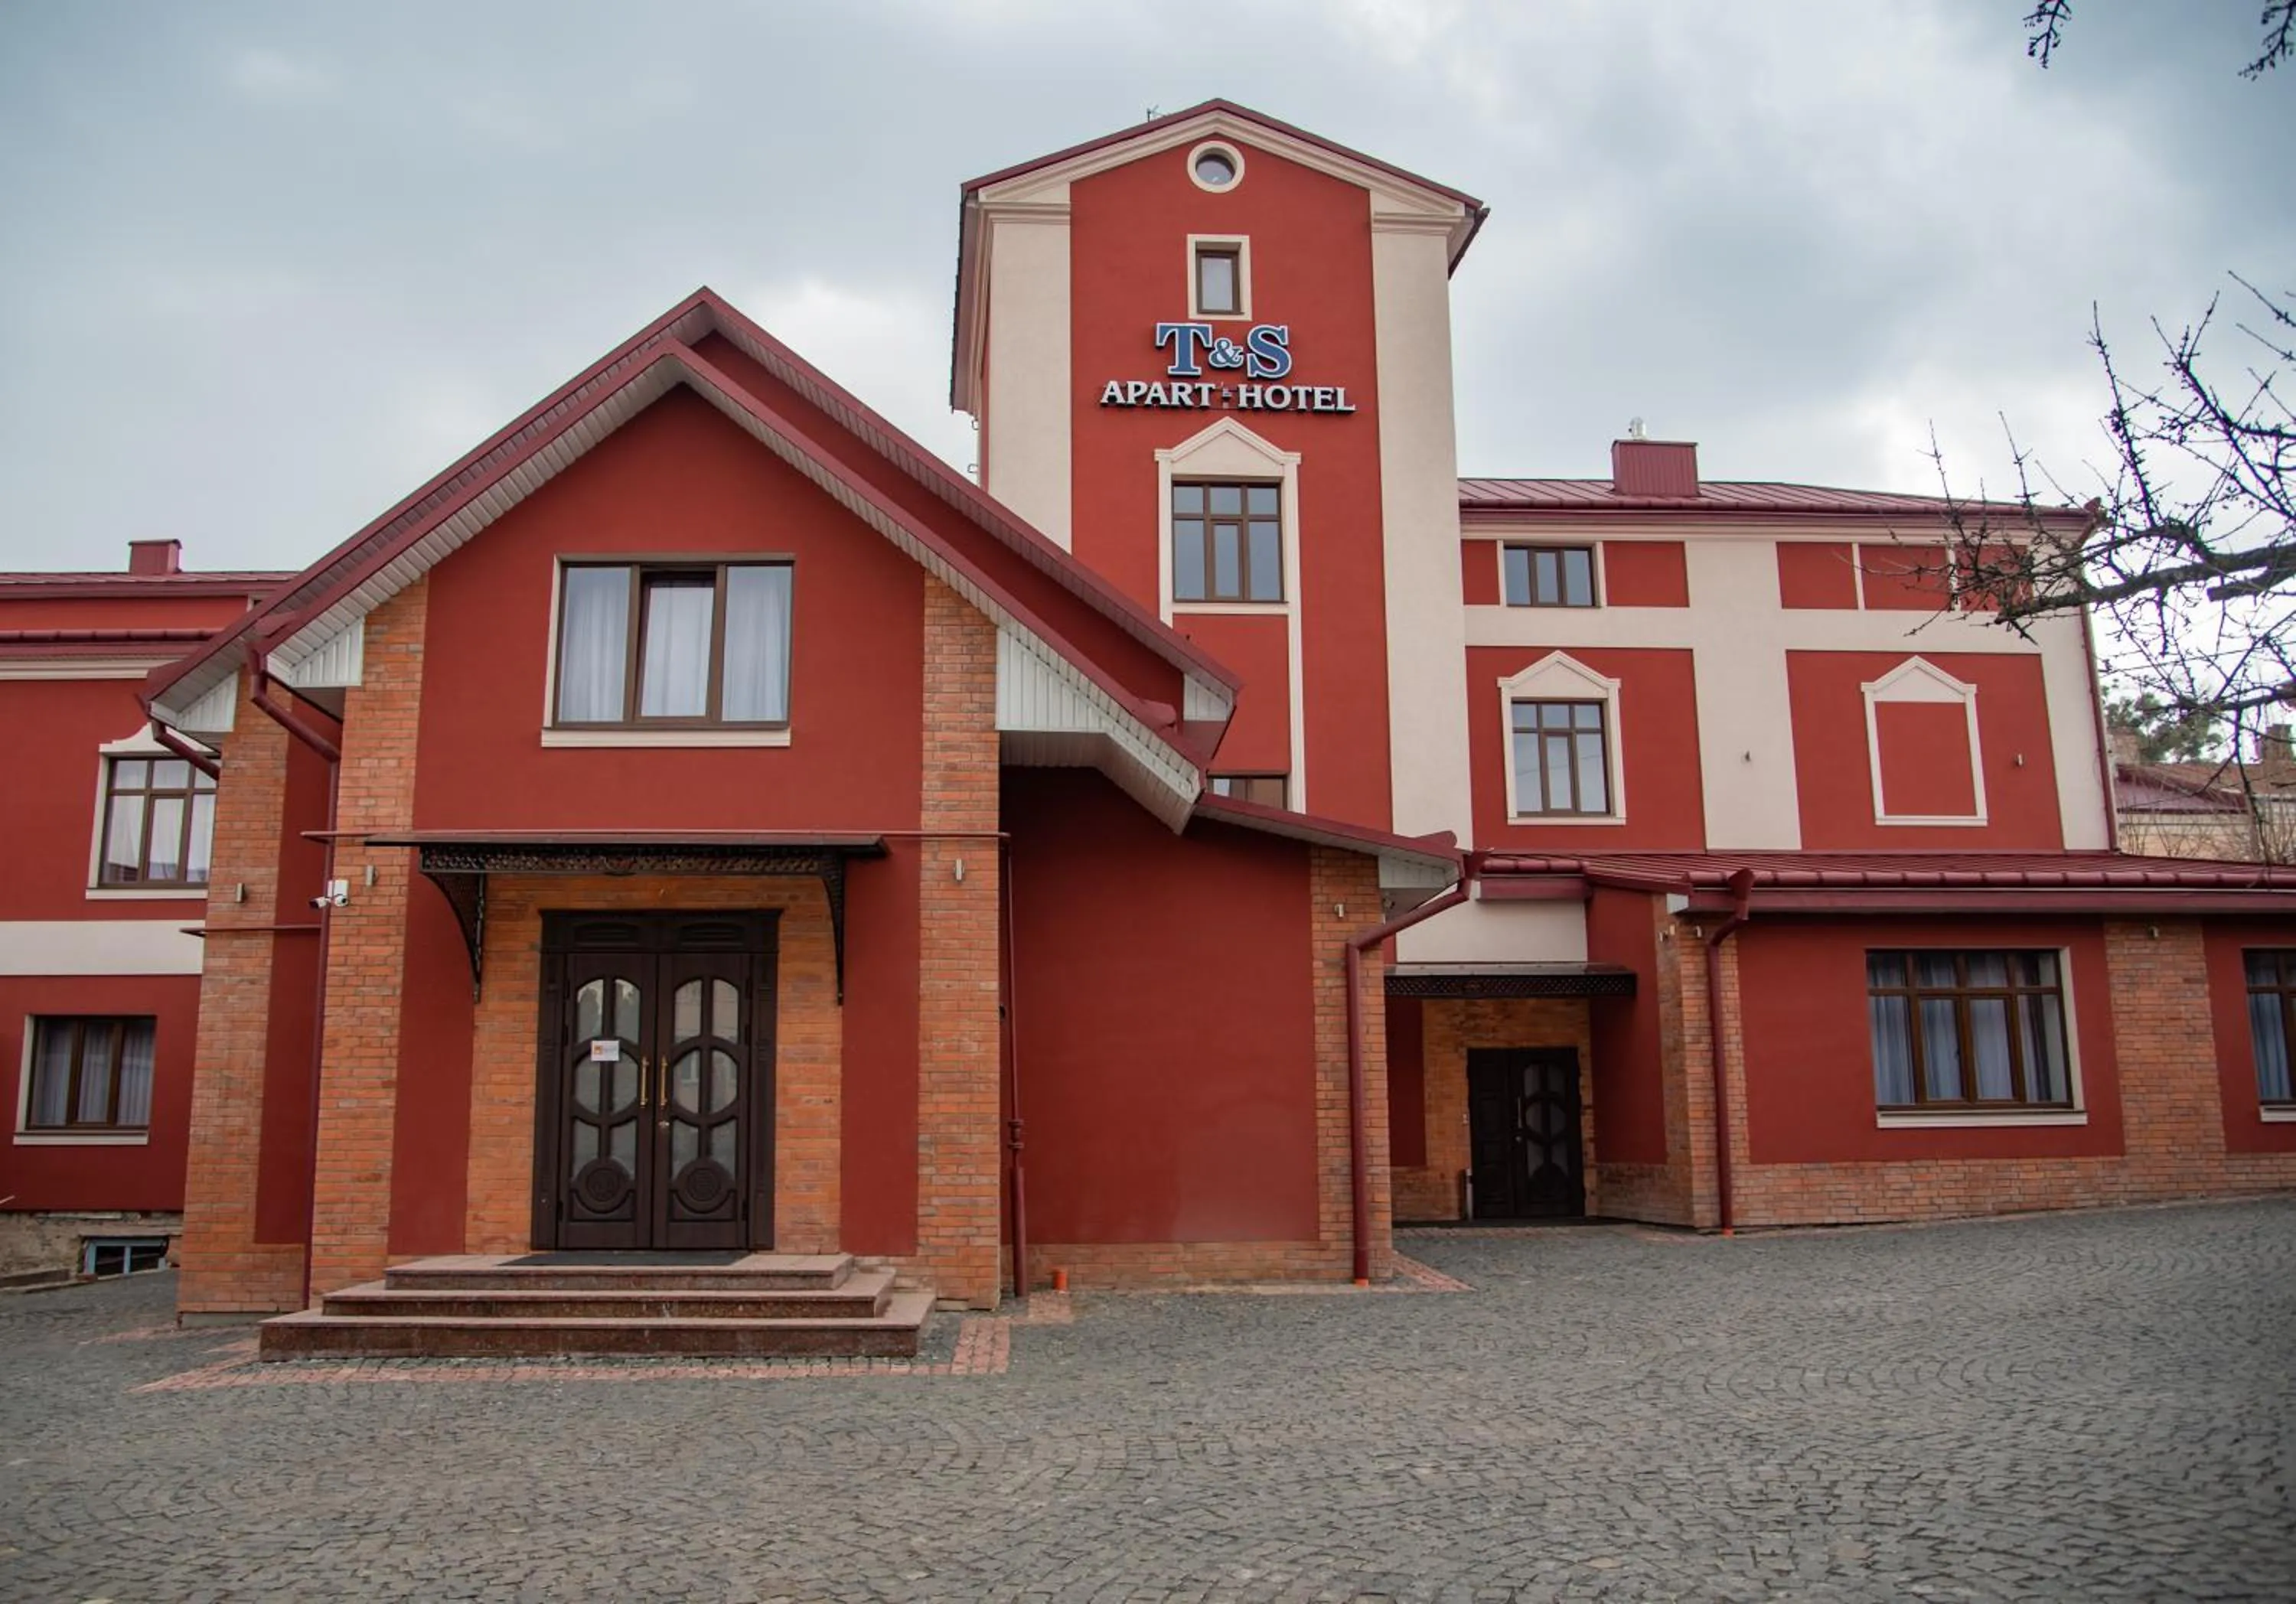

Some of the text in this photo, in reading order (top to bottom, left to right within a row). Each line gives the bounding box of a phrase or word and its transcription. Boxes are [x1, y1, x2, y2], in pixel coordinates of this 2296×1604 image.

[1156, 323, 1292, 378] T&S
[1100, 380, 1356, 411] APART HOTEL
